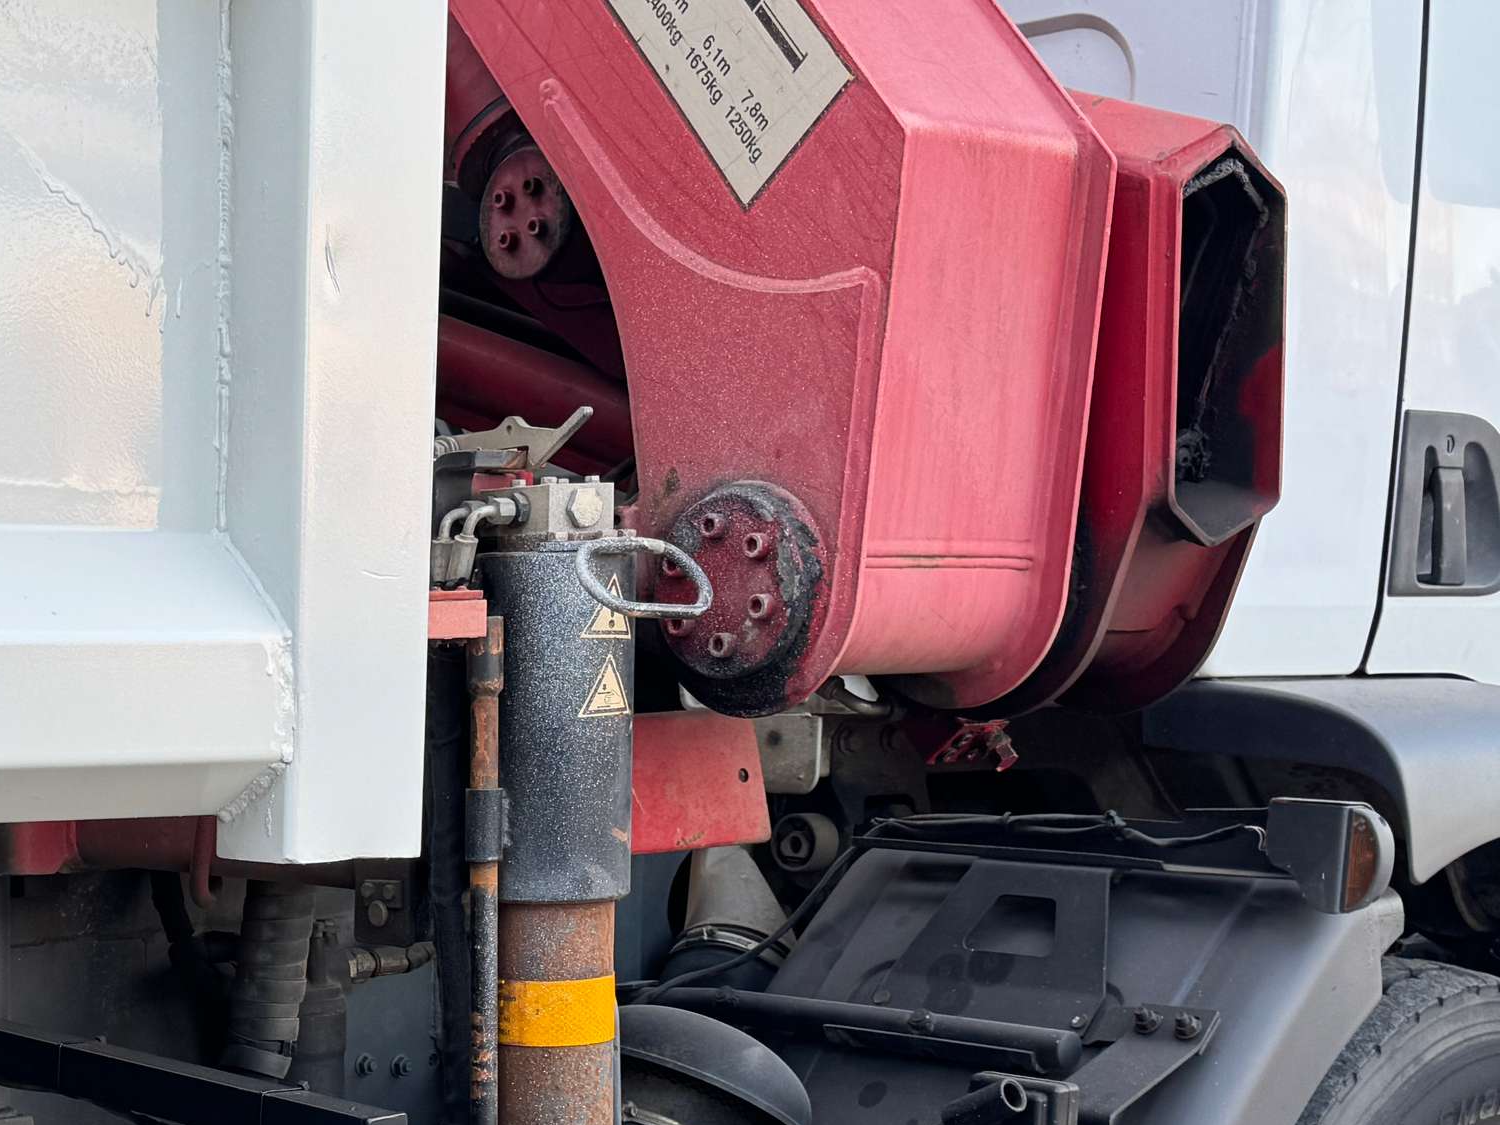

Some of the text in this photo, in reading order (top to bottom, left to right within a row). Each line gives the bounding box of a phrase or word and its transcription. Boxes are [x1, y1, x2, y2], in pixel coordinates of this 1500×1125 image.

[646, 0, 763, 164] 400kg 1675kg 1250kg
[703, 35, 731, 76] 6,1m
[741, 89, 769, 131] 7,8m
